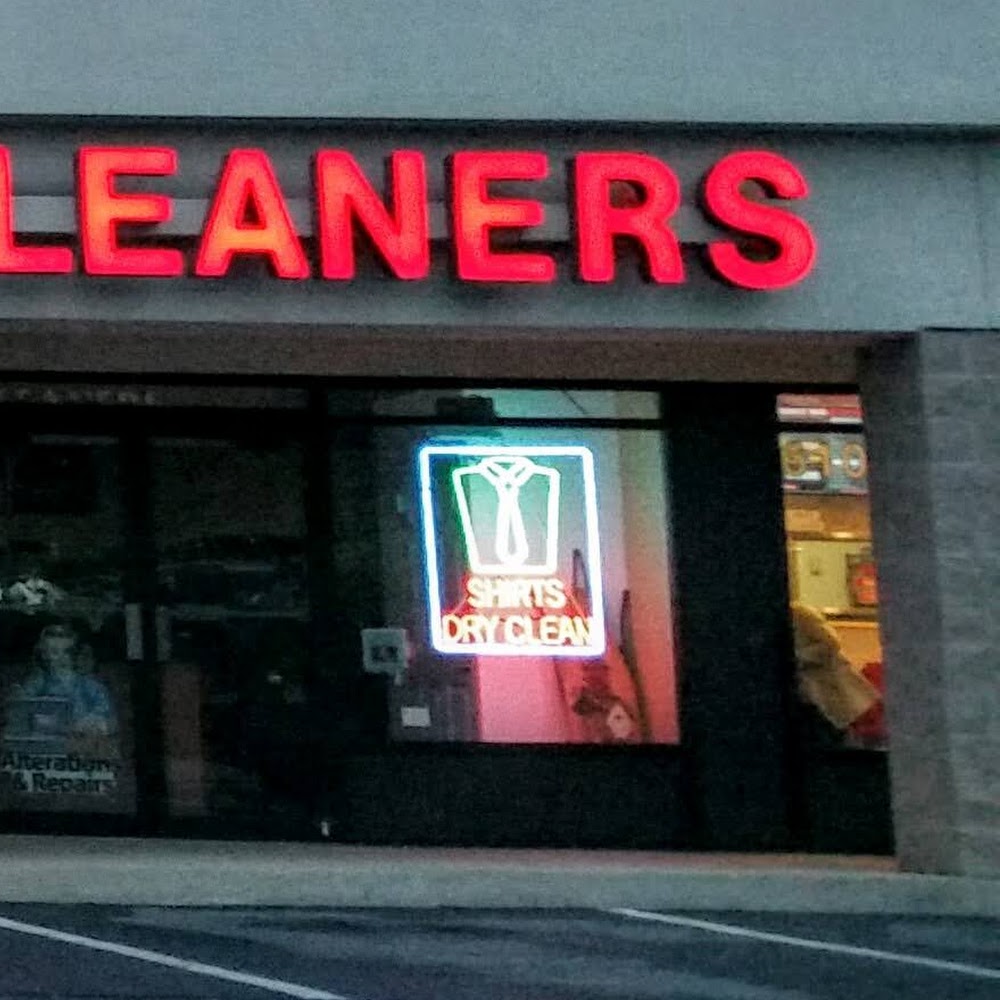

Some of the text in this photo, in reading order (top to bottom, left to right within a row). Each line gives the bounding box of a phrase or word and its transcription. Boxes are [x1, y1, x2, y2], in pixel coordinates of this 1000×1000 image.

[467, 578, 566, 608] SHIRTS
[443, 614, 592, 646] DRY CLEAN
